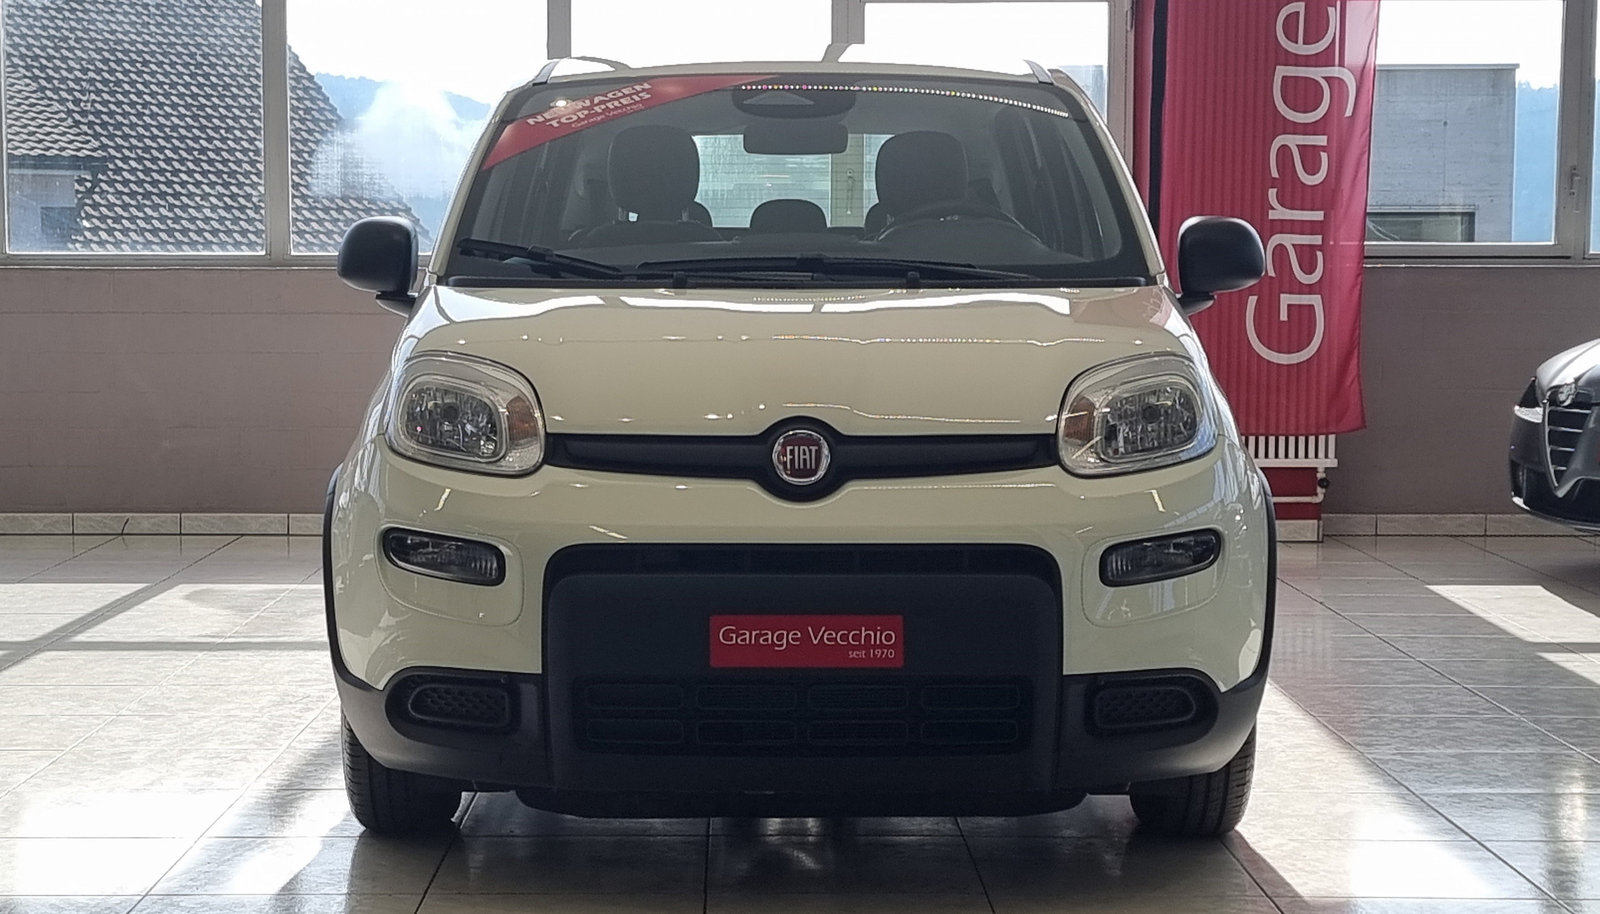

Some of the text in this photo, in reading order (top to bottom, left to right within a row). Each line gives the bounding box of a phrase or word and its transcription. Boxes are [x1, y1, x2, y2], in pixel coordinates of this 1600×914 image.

[546, 91, 651, 127] TOP-PREIS
[1246, 1, 1356, 365] Garage
[786, 445, 818, 469] FIAT
[719, 626, 896, 650] Garage Vecchio
[848, 649, 895, 658] seit 1970
